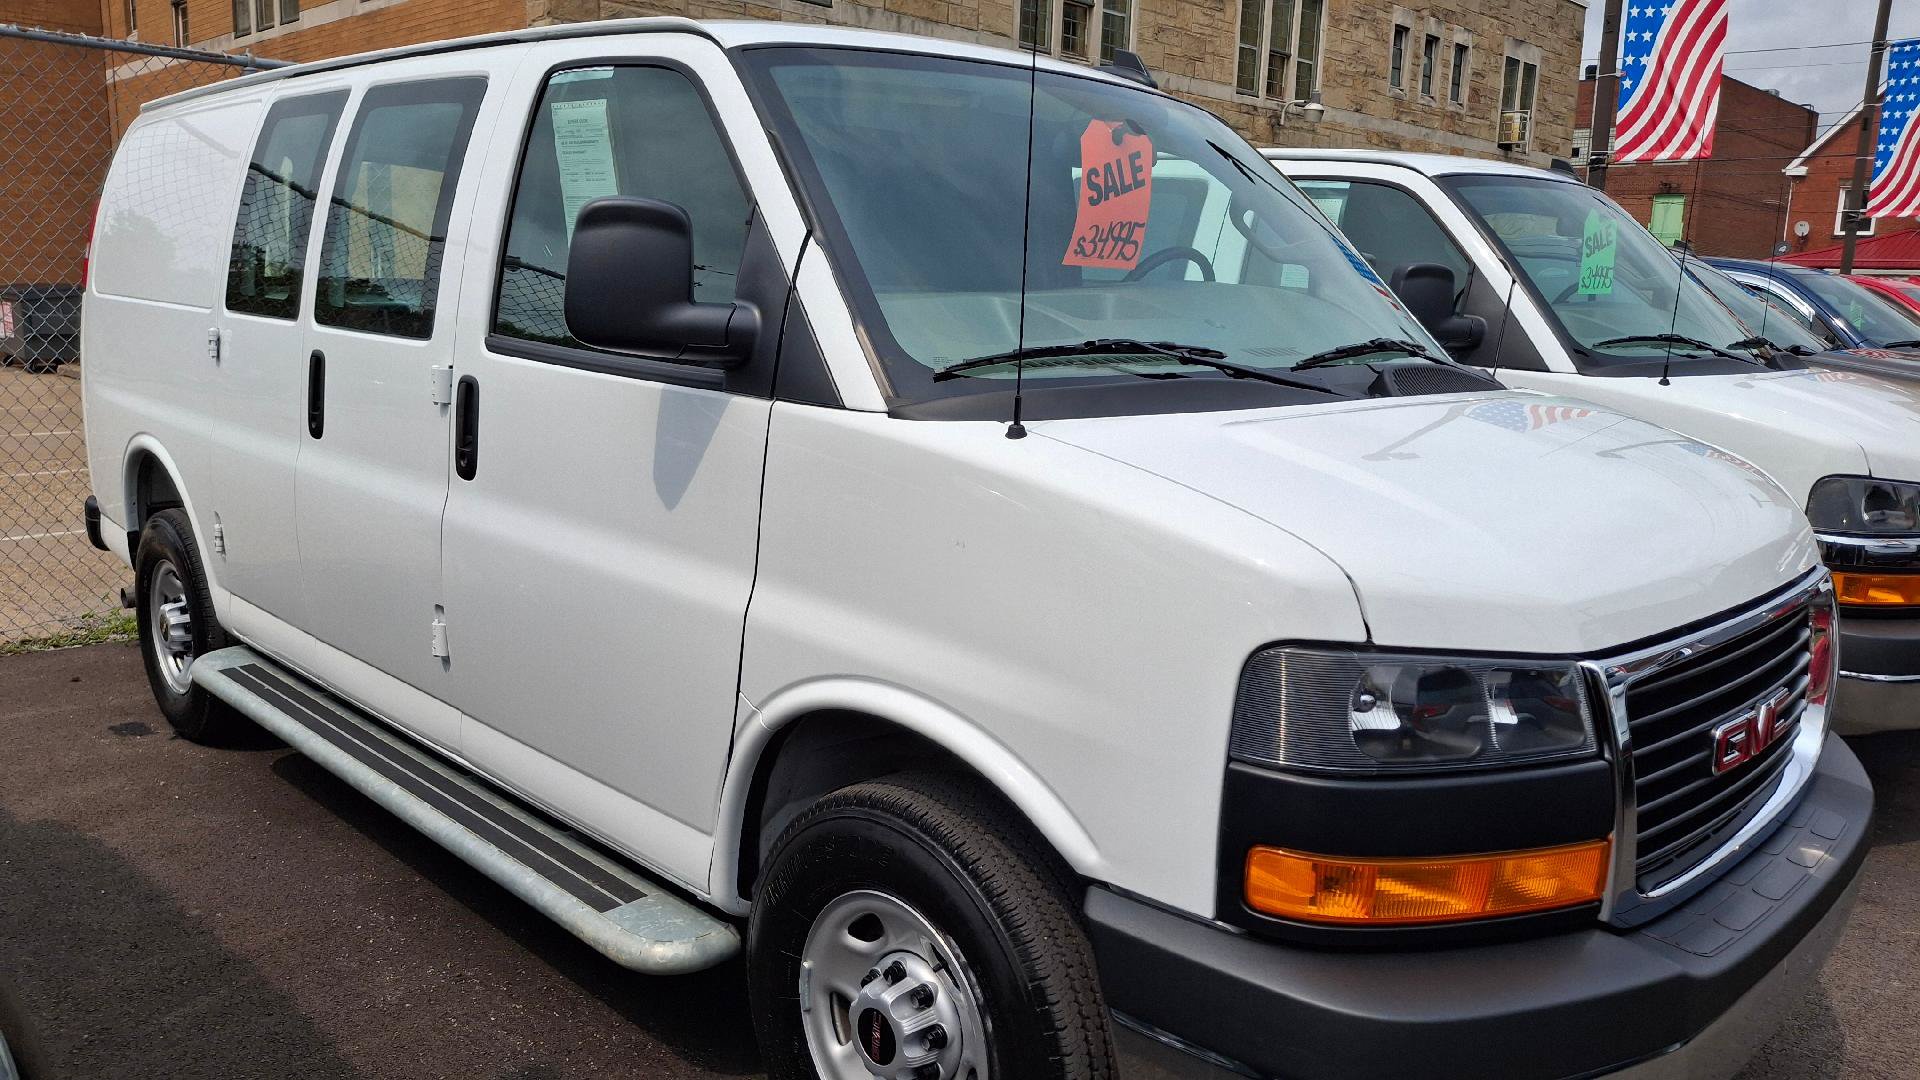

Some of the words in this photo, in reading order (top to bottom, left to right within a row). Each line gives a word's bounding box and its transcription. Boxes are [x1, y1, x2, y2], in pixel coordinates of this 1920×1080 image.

[1087, 152, 1146, 206] SALE
[1585, 224, 1612, 258] SALE
[1713, 687, 1792, 775] GMC
